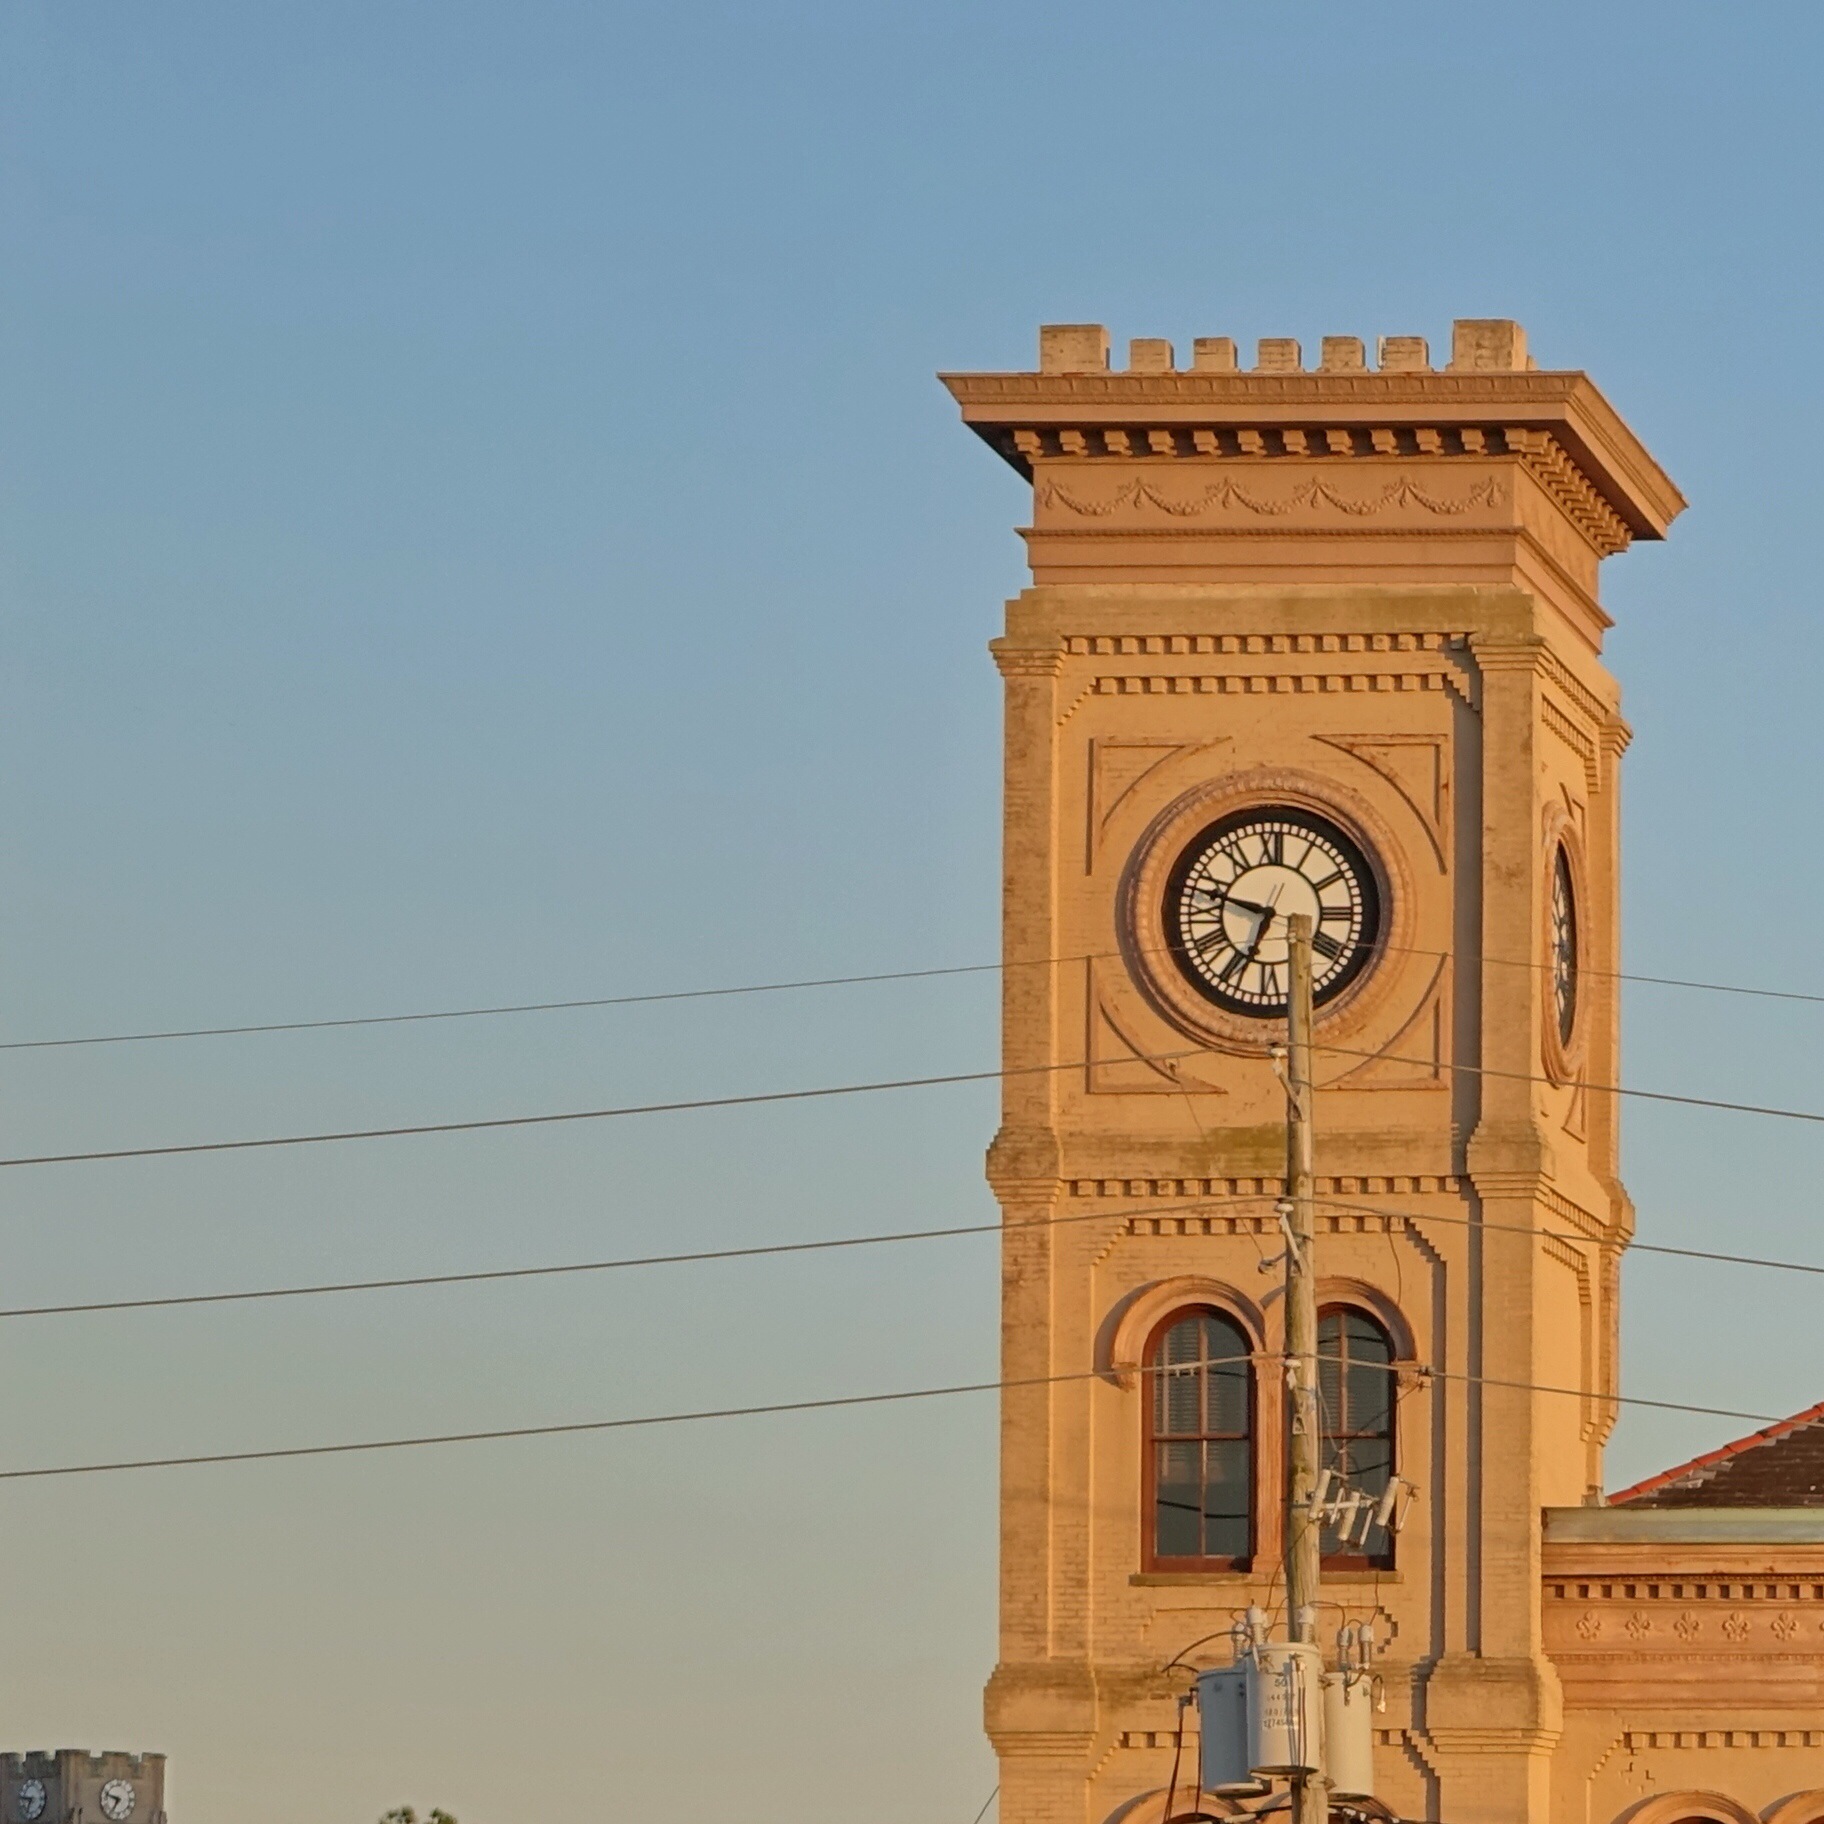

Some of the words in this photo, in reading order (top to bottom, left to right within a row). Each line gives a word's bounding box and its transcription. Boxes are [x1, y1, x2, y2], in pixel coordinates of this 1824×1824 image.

[1220, 841, 1252, 878] XI
[1259, 833, 1284, 866] XII
[1296, 843, 1315, 871] I
[1314, 870, 1344, 891] II
[1321, 905, 1353, 921] III
[1195, 929, 1231, 964] VIII
